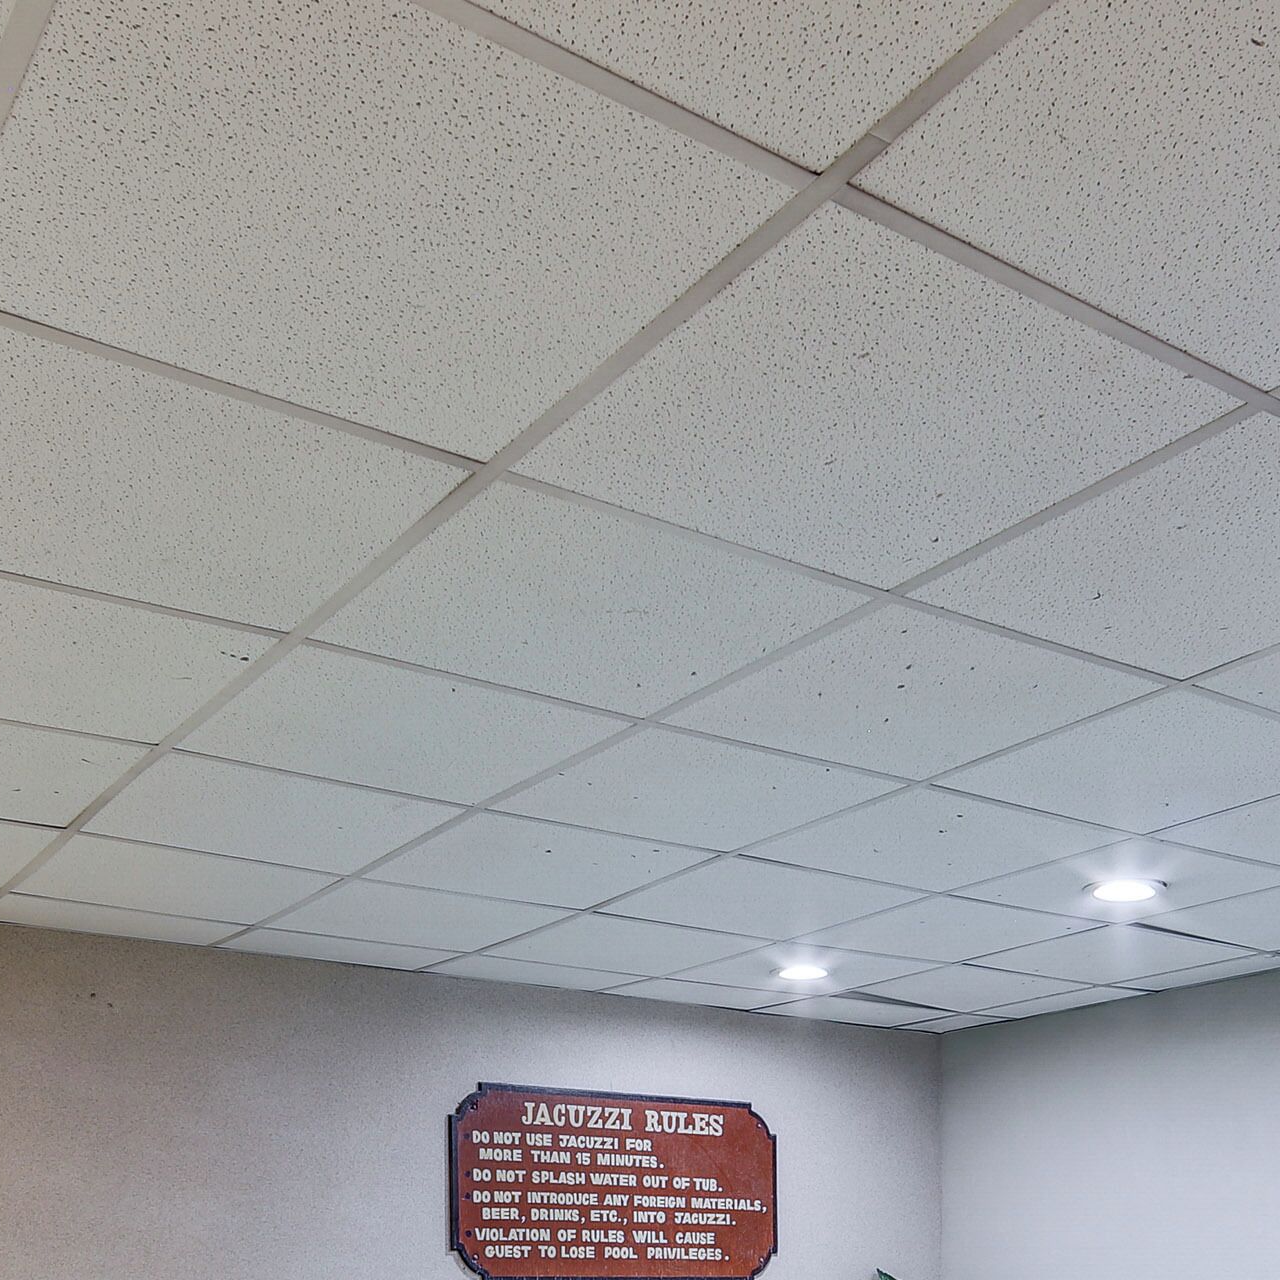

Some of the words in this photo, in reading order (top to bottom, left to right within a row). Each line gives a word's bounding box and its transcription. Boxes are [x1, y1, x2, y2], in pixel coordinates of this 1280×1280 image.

[521, 1102, 632, 1130] JACUZZI
[644, 1110, 724, 1137] RULES
[472, 1130, 490, 1144] DO
[493, 1132, 521, 1145] NOT
[525, 1133, 553, 1146] USE
[558, 1134, 619, 1150] JACUZZI
[625, 1138, 652, 1152] FOR
[479, 1148, 522, 1162] MORE
[531, 1150, 570, 1164] THAN
[575, 1152, 591, 1165] 15
[596, 1153, 665, 1169] MINUTES.
[472, 1168, 492, 1182] DO
[495, 1169, 526, 1183] NOT
[531, 1171, 586, 1185] SPLASH
[589, 1172, 637, 1187] WATER
[642, 1175, 669, 1189] OUT
[672, 1176, 691, 1190] OF
[693, 1178, 723, 1192] TUB.
[472, 1190, 491, 1203] DO
[493, 1191, 521, 1203] NOT
[527, 1191, 598, 1206] INTRODUCE
[603, 1194, 629, 1207] ANY
[633, 1194, 686, 1209] FOREIGN
[690, 1197, 767, 1213] MATERIALS,
[481, 1207, 526, 1223] BEER,
[530, 1208, 585, 1224] DRINKS,
[589, 1209, 628, 1225] ETC.,
[633, 1211, 666, 1224] INTO
[674, 1212, 737, 1226] JACUZZI.
[474, 1227, 551, 1242] VIOLATION
[557, 1229, 577, 1242] OF
[581, 1229, 625, 1243] RULES
[632, 1230, 668, 1244] WILL
[675, 1232, 715, 1245] CAUSE
[484, 1245, 531, 1258] GUEST
[538, 1245, 556, 1258] TO
[560, 1246, 595, 1259] LOSE
[604, 1246, 638, 1260] POOL
[647, 1247, 730, 1261] PRIVILEGES.
